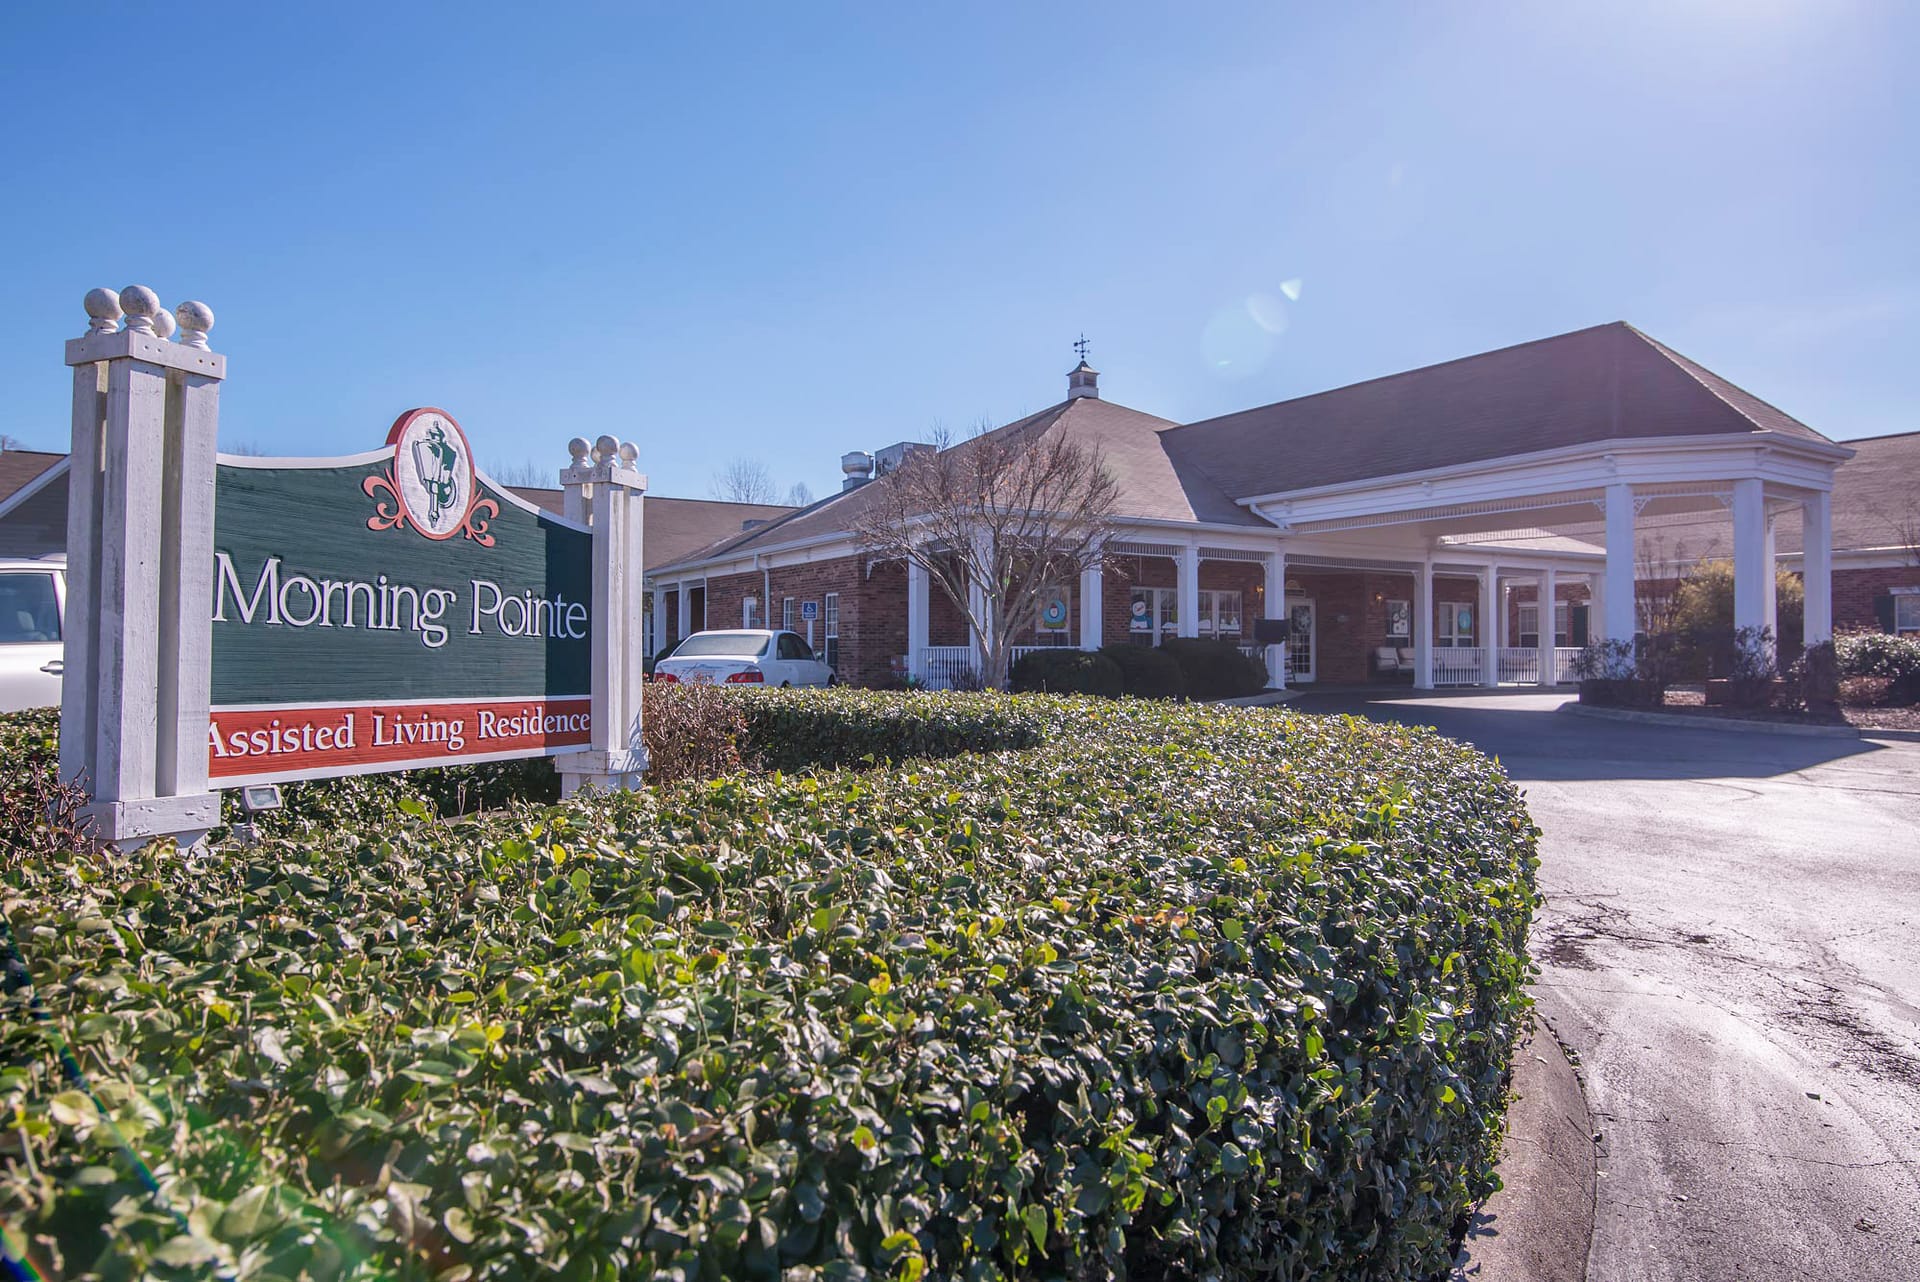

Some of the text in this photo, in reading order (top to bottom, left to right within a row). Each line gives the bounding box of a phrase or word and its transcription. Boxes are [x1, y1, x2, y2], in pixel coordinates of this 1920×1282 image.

[212, 552, 588, 649] Morning Pointe
[208, 706, 591, 758] Assisted Living Residence
